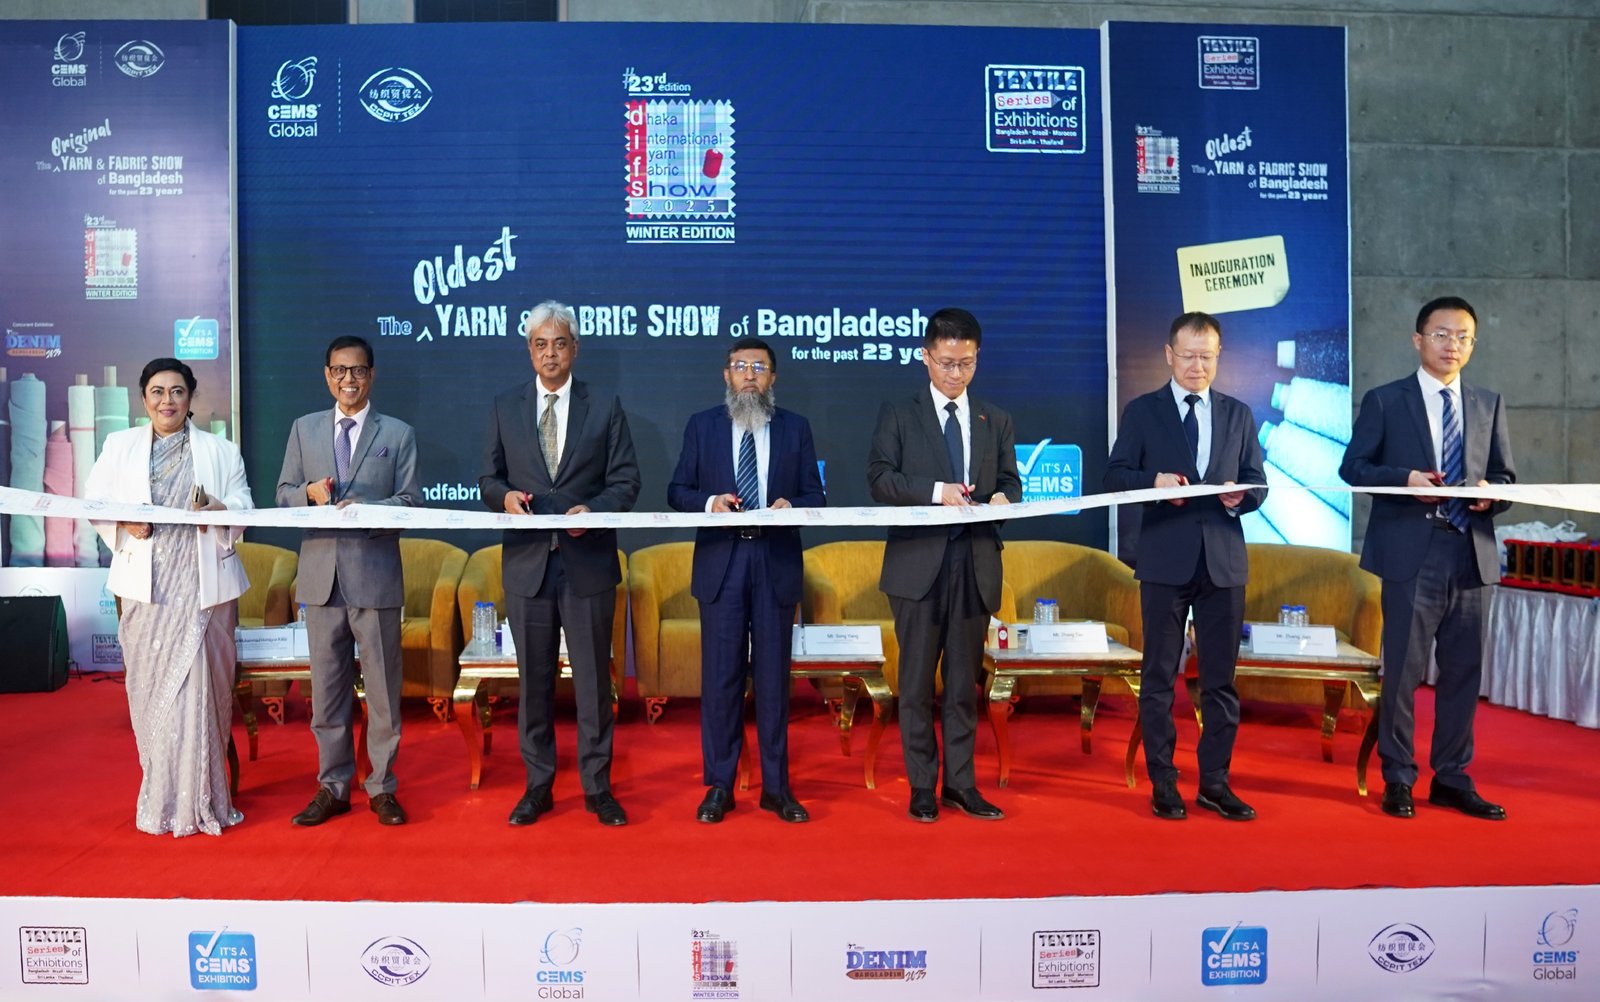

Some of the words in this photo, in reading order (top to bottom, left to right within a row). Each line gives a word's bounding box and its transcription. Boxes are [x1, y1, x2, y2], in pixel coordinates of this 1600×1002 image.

[1203, 40, 1254, 52] TEXTILE
[1244, 55, 1254, 65] of
[51, 65, 86, 75] CEMS
[1204, 64, 1255, 75] Exhibitions
[52, 76, 87, 87] Global
[658, 82, 692, 92] edition
[993, 70, 1077, 91] TEXTILE
[997, 94, 1050, 107] Series
[1062, 96, 1077, 111] of
[268, 104, 319, 119] CEMS
[370, 103, 400, 120] CCPIT
[402, 103, 421, 118] TEX
[994, 111, 1078, 128] Exhibitions
[269, 122, 318, 138] Global
[995, 128, 1029, 137] Bangladesh
[51, 118, 112, 157] Original
[1040, 138, 1064, 146] Thailand
[1205, 126, 1252, 160] Oldest
[648, 150, 676, 162] yarn
[36, 161, 52, 171] The
[61, 156, 93, 171] YARN
[96, 159, 105, 170] &
[108, 156, 148, 171] FABRIC
[151, 155, 183, 170] SHOW
[1191, 164, 1206, 174] The
[1214, 161, 1244, 175] YARN
[1247, 164, 1256, 175] &
[1259, 162, 1295, 176] FABRIC
[1298, 163, 1328, 177] SHOW
[97, 174, 106, 185] of
[108, 172, 183, 187] Bangladesh
[1248, 178, 1257, 189] of
[1259, 177, 1328, 192] Bangladesh
[109, 188, 117, 196] for
[117, 188, 126, 196] the
[139, 187, 153, 196] 23
[155, 188, 183, 197] years
[1288, 191, 1300, 199] 23
[1302, 192, 1328, 201] years
[626, 226, 679, 239] WINTER
[682, 226, 735, 239] EDITION
[413, 226, 519, 305] Oldest
[1190, 253, 1276, 278] INAUGURATION
[1205, 271, 1265, 292] CEREMONY
[377, 316, 412, 335] The
[435, 304, 507, 337] YARN
[565, 305, 638, 336] BRIC
[647, 304, 720, 337] SHOW
[729, 315, 750, 338] of
[757, 308, 929, 343] Bangladesh
[6, 335, 61, 348] DENIM
[178, 337, 214, 347] CEMS
[792, 346, 808, 360] for
[811, 346, 831, 360] the
[833, 348, 858, 362] past
[863, 343, 893, 361] 23
[1041, 463, 1060, 473] IT'S
[1063, 463, 1072, 473] A
[25, 930, 81, 943] TEXTILE
[1039, 934, 1095, 947] TEXTILE
[27, 945, 64, 955] Series
[72, 947, 81, 956] of
[220, 946, 237, 956] IT'S
[239, 946, 248, 956] A
[1232, 942, 1250, 951] IT'S
[1251, 941, 1259, 951] A
[846, 950, 927, 969] DENIM
[1040, 949, 1076, 959] Series
[1085, 950, 1095, 959] of
[1207, 952, 1261, 969] CEMS
[1533, 951, 1577, 963] CEMS
[26, 957, 83, 968] Exhibitions
[195, 957, 251, 973] CEMS
[1038, 961, 1095, 972] Exhibitions
[1377, 956, 1405, 970] CCPIT
[1407, 956, 1424, 969] TEX
[198, 975, 250, 983] EXHIBITION
[371, 969, 401, 984] CCPIT
[404, 970, 421, 983] TEX
[536, 970, 584, 983] CEMS
[1209, 970, 1260, 979] EXHIBITION
[1533, 967, 1576, 980] Global
[538, 986, 584, 999] Global
